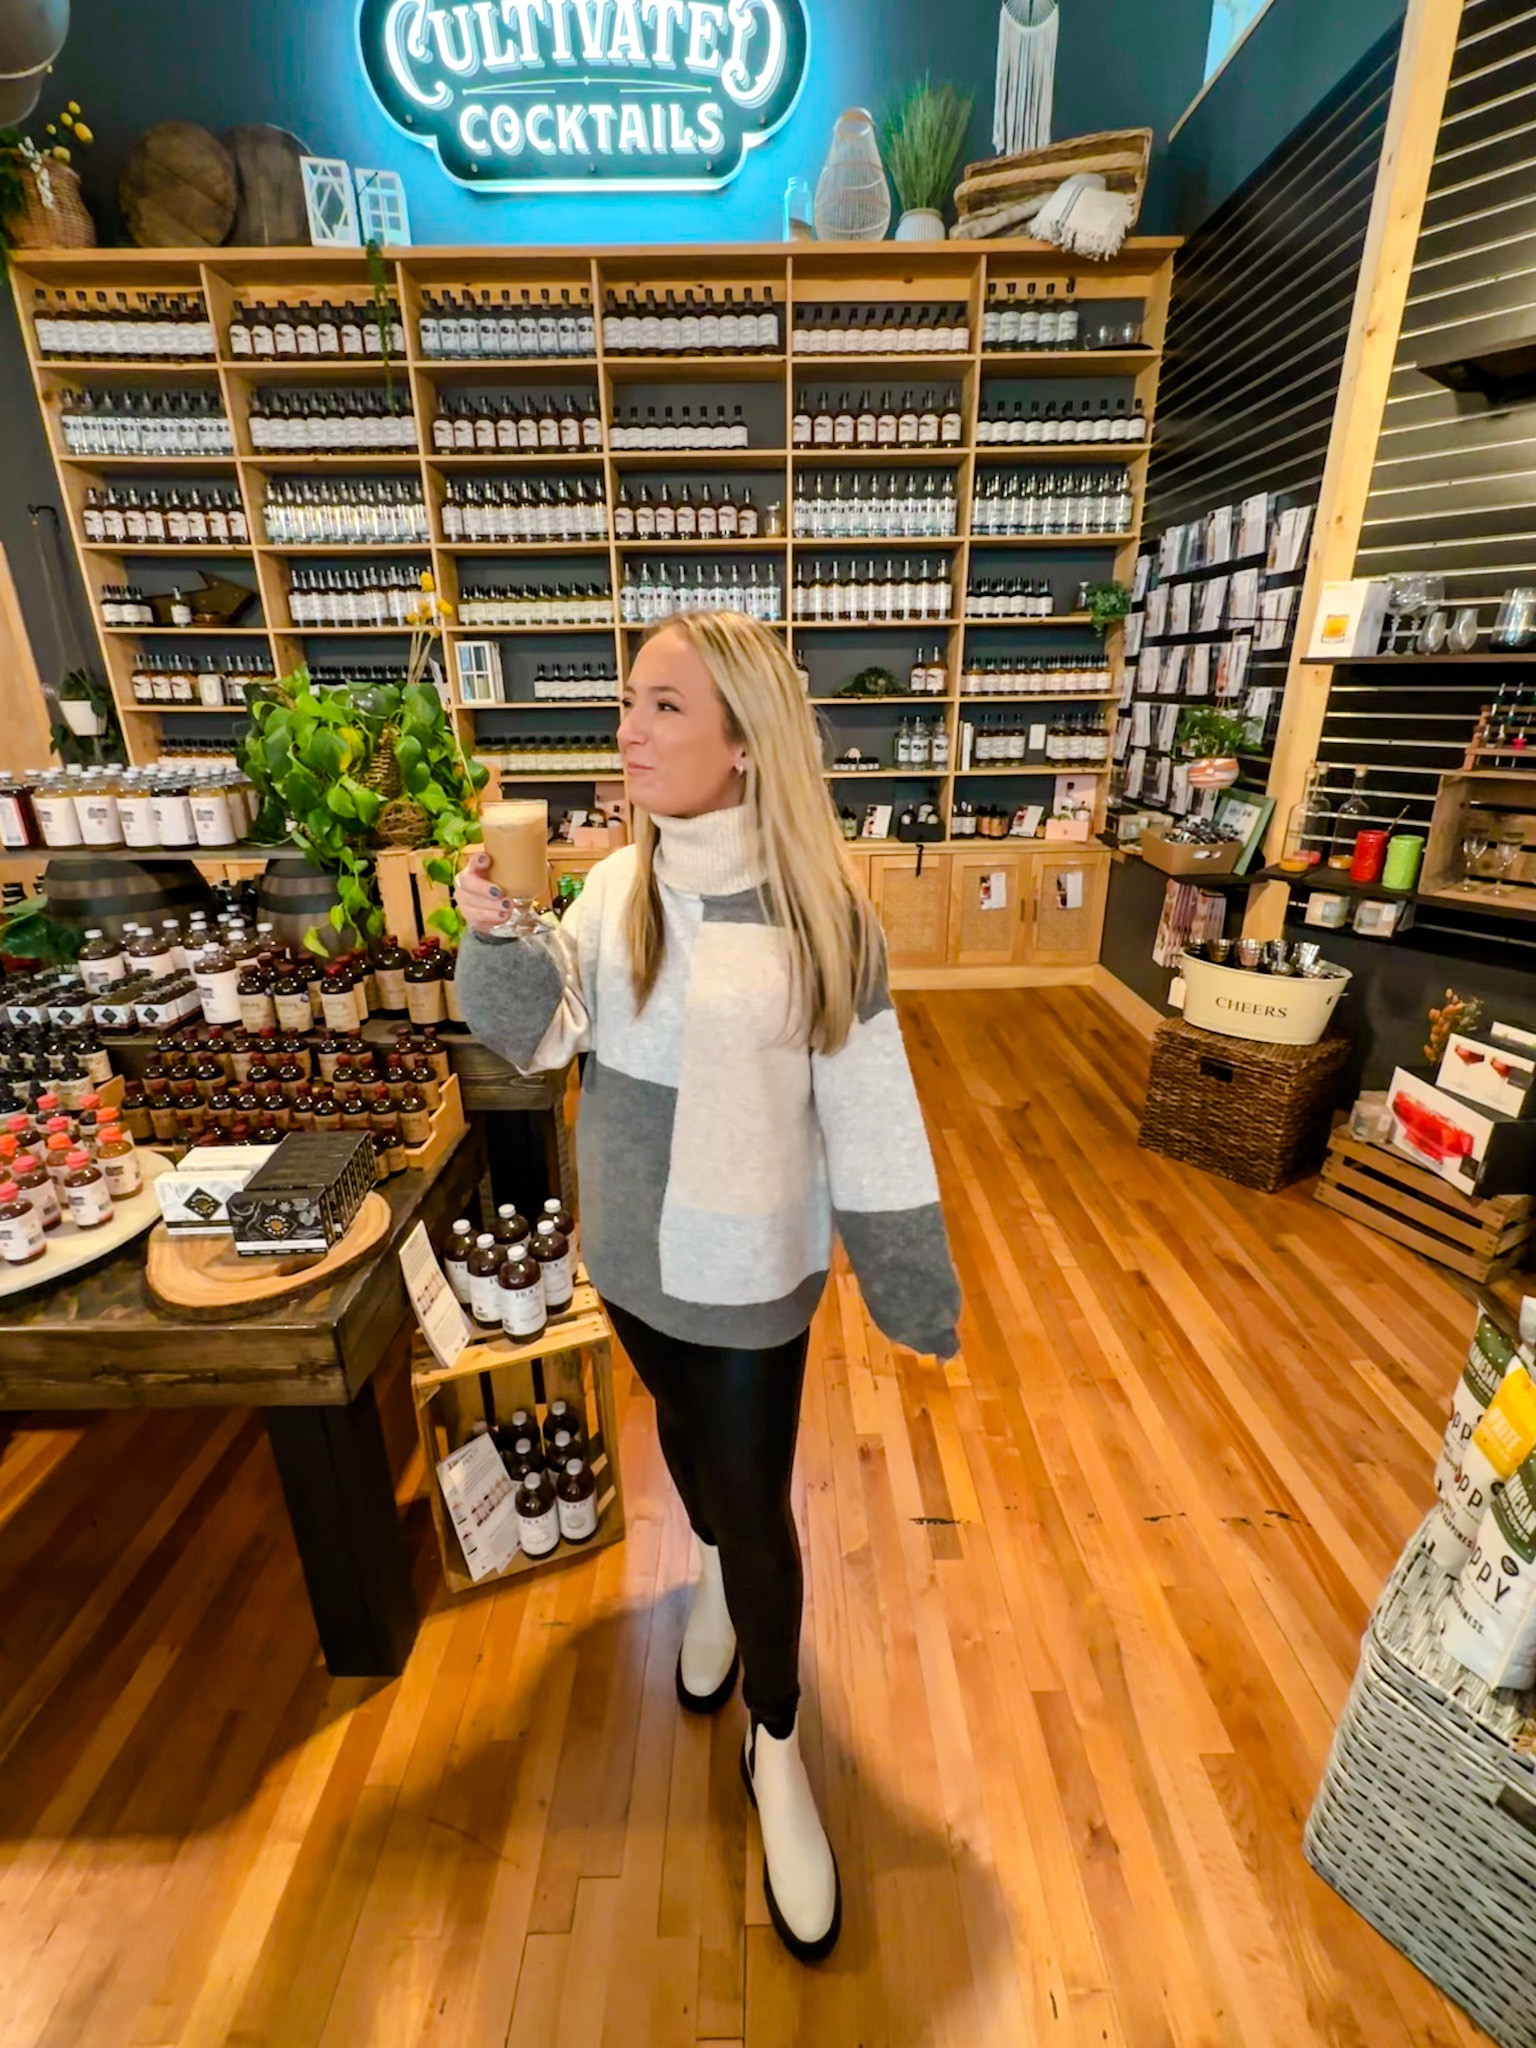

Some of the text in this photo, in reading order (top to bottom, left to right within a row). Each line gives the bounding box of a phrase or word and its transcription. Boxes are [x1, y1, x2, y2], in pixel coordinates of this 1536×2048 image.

[383, 0, 786, 107] CULTIVATED
[458, 102, 724, 154] COCKTAILS
[1215, 996, 1288, 1019] CHEERS
